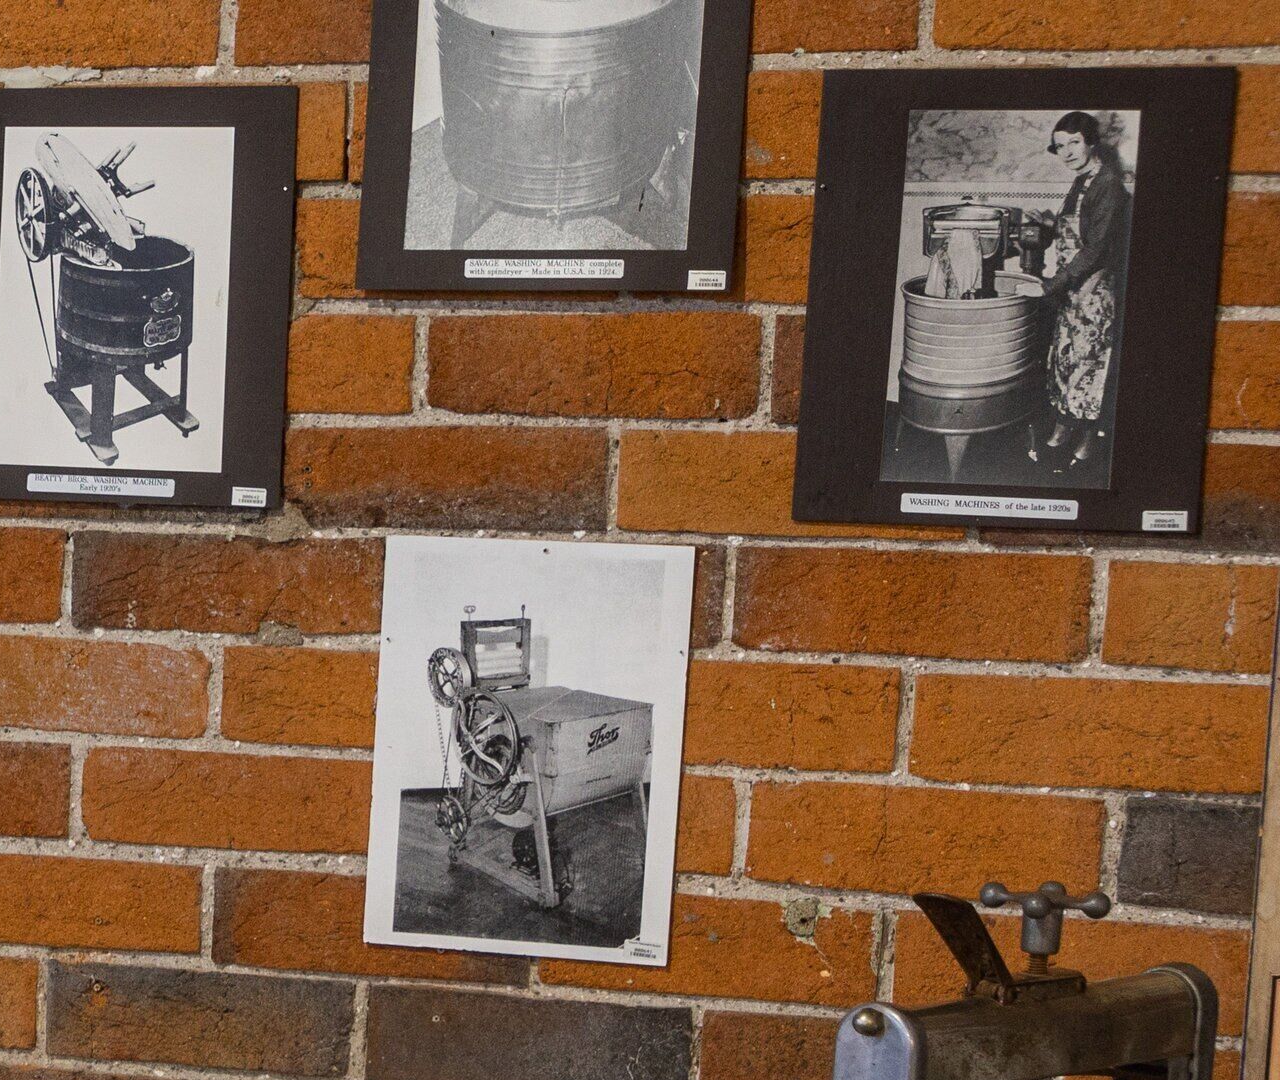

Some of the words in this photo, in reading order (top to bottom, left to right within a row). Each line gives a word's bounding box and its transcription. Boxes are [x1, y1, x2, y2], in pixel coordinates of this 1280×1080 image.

[590, 260, 624, 269] complete
[487, 268, 522, 276] spindryer
[80, 483, 97, 492] Early
[910, 498, 949, 507] WASHING
[955, 500, 1000, 509] MACHINES
[1005, 501, 1013, 509] of
[1031, 502, 1045, 510] late
[1049, 503, 1071, 511] 1920s
[587, 723, 621, 755] Thor
